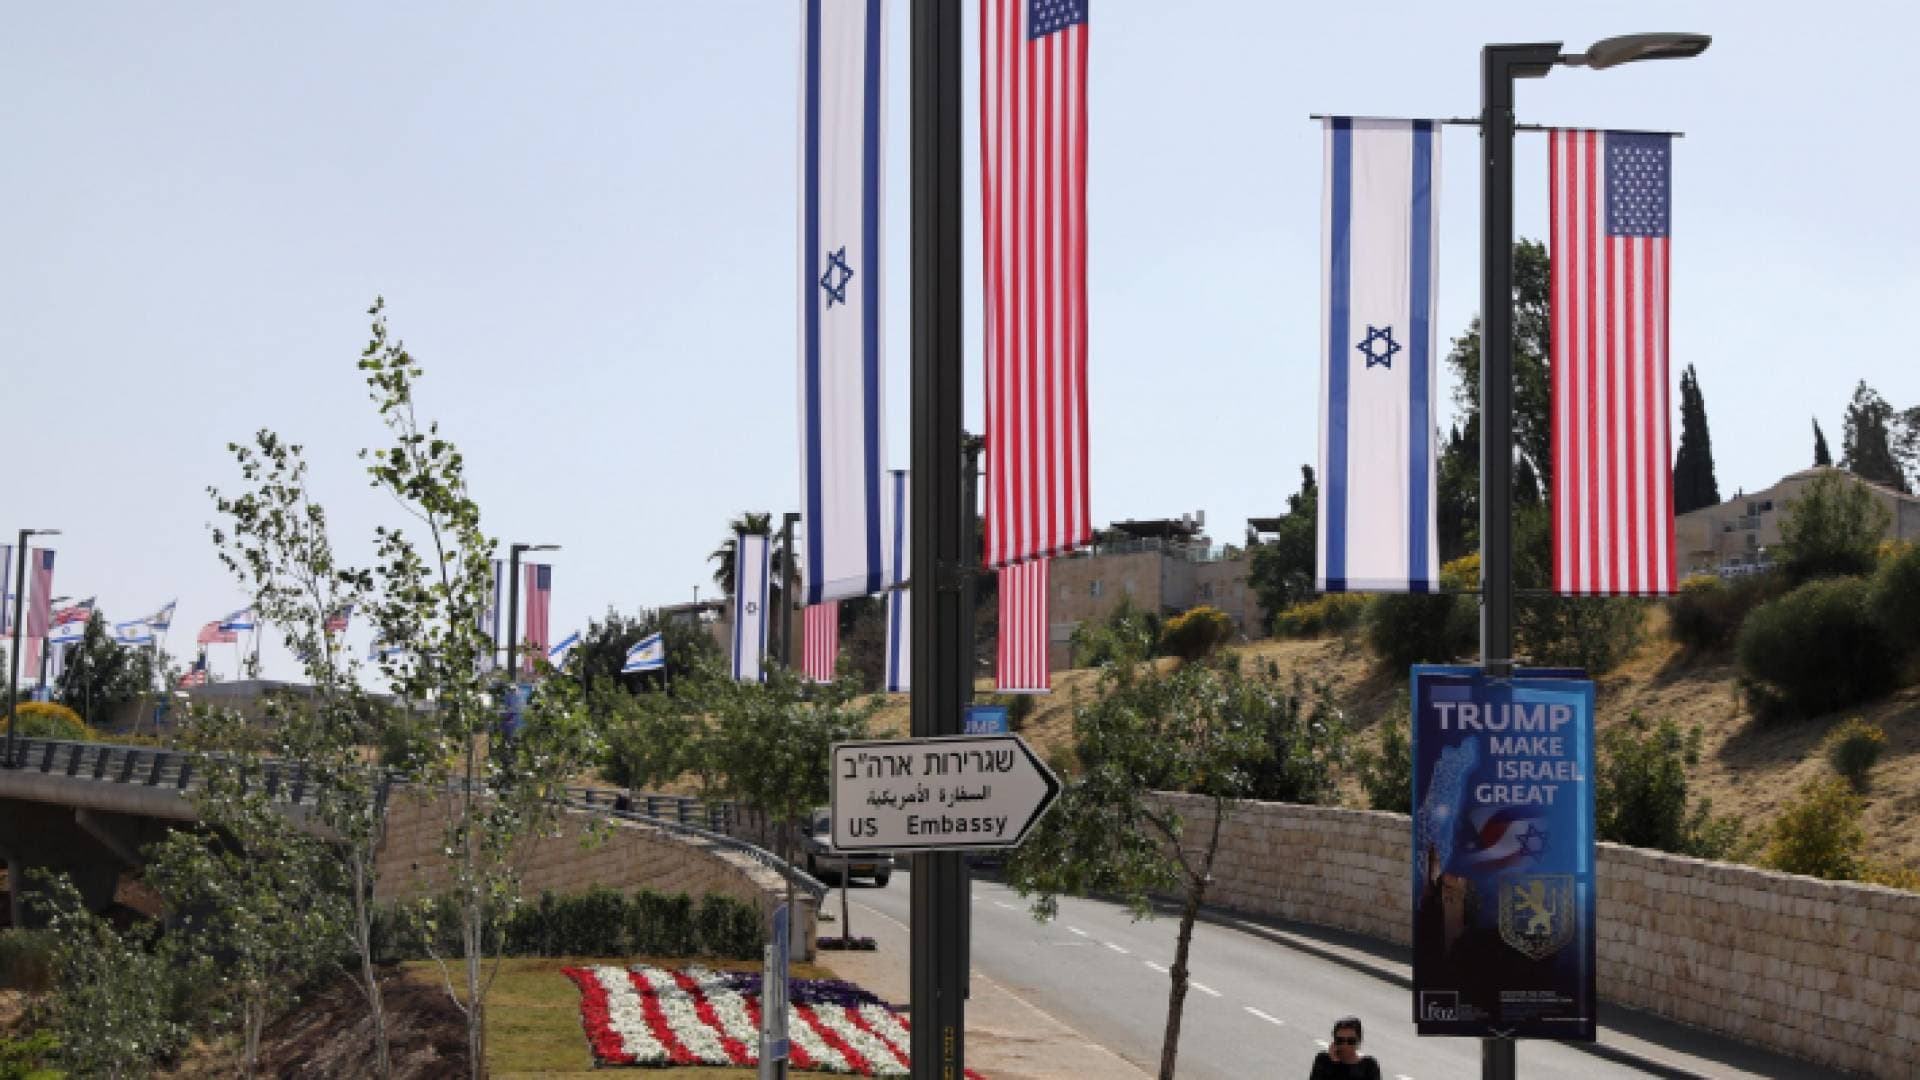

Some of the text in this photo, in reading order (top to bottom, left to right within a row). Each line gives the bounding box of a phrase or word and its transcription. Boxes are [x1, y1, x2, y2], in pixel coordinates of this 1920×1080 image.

[1433, 702, 1572, 732] TRUMP
[1490, 736, 1564, 756] MAKE
[923, 750, 1015, 776] שגרירות
[1498, 761, 1585, 781] ISRAEL
[1475, 785, 1558, 805] GREAT
[849, 815, 1008, 837] US Embassy
